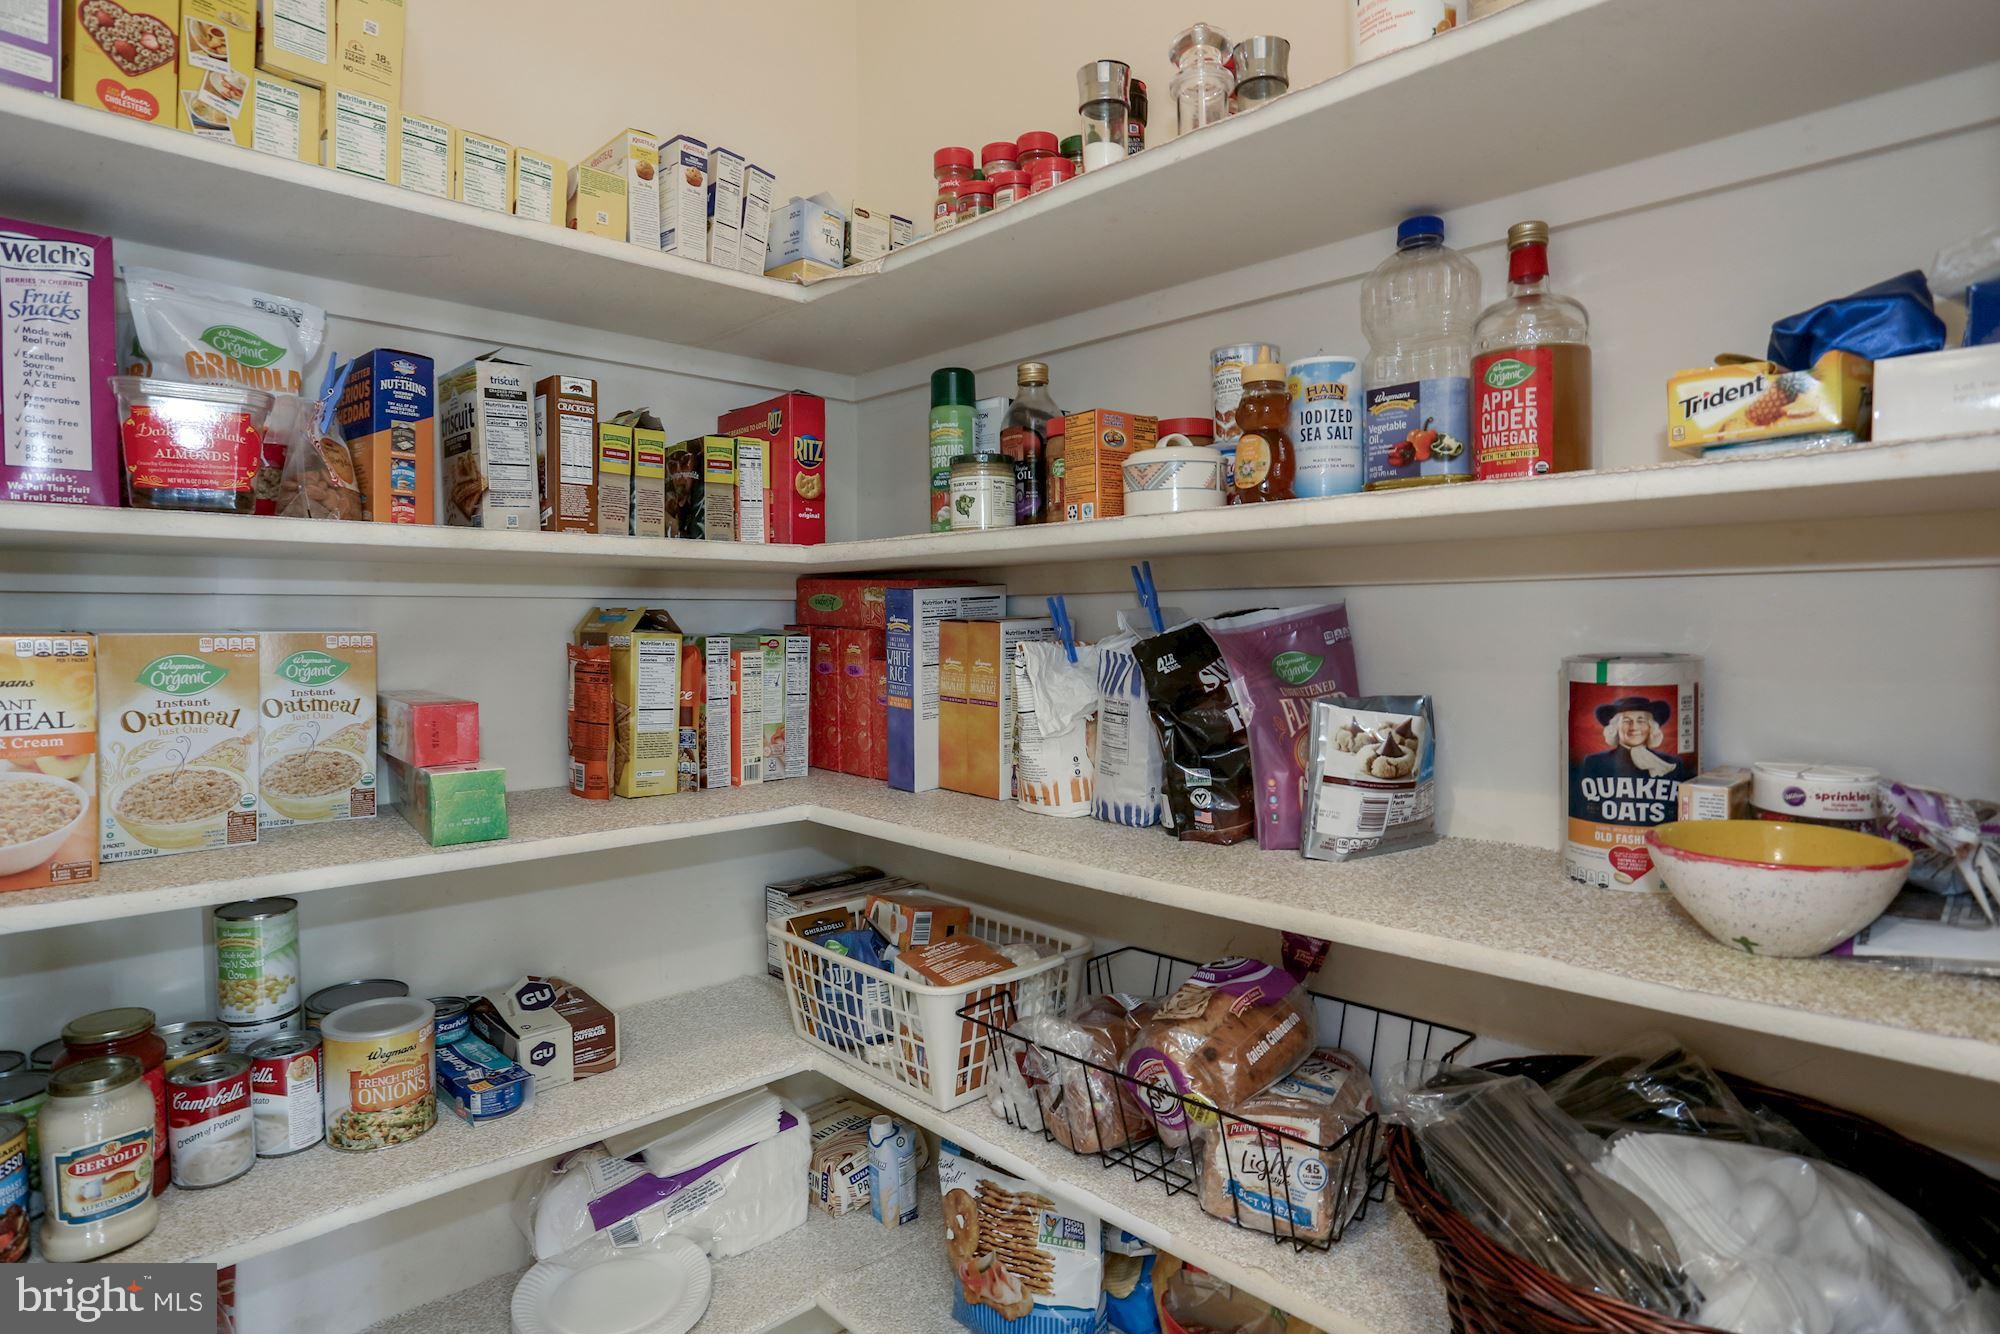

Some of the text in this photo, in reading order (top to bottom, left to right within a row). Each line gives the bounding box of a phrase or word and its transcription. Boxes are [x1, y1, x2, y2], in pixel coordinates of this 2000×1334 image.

[105, 95, 153, 116] CHOLESTEROL
[373, 121, 387, 133] 230
[434, 144, 447, 155] 230
[824, 234, 841, 249] TEA
[1, 242, 92, 268] Welch's
[48, 280, 85, 289] CHERRIES
[23, 289, 73, 306] Fruit
[8, 301, 81, 321] Snacks
[23, 327, 73, 341] Made with
[23, 336, 66, 349] Real Fruit
[213, 337, 269, 362] Organic
[23, 351, 65, 364] Excellent
[23, 361, 56, 372] Source
[184, 351, 302, 393] GRANOLA
[23, 370, 77, 383] of Vitamins
[490, 375, 520, 387] triscuit
[1489, 368, 1524, 386] Organic
[380, 379, 427, 398] NUT-THINS
[1307, 384, 1345, 397] HAIN
[24, 393, 81, 407] Preservative
[1375, 391, 1411, 404] Wegmans
[1482, 387, 1537, 412] APPLE
[1679, 374, 1766, 419] Trident
[24, 402, 46, 411] Free
[558, 402, 595, 415] CRACKERS
[25, 415, 80, 428] Gluten Free
[442, 402, 475, 438] triscuit
[515, 420, 528, 428] 120
[767, 410, 783, 432] RITZ
[1301, 408, 1353, 426] IODIZED
[1481, 407, 1538, 434] CIDER
[136, 424, 178, 437] Dark
[1301, 426, 1353, 442] SEA SALT
[1368, 421, 1407, 435] Vegetable
[25, 430, 64, 441] Fat Free
[1369, 435, 1379, 445] Oil
[1481, 429, 1539, 449] VINEGAR
[41, 446, 75, 457] Calorie
[154, 449, 231, 462] ALMONDS
[794, 436, 824, 462] RITZ
[1497, 451, 1508, 459] THE
[1510, 449, 1537, 458] MOTHER
[26, 455, 64, 466] Pouches
[1017, 470, 1034, 481] OIL
[47, 484, 65, 494] The
[67, 485, 91, 496] Fruit
[23, 492, 48, 503] Fruit
[798, 512, 821, 520] original
[159, 659, 205, 673] Wegmans
[293, 655, 331, 667] Wegmans
[887, 650, 911, 668] WHITE
[286, 664, 336, 682] Organic
[889, 668, 907, 683] RICE
[151, 671, 211, 691] Organic
[157, 698, 211, 708] Instant
[262, 698, 361, 719] Oatmeal
[121, 708, 241, 734] Oatmeal
[313, 712, 334, 720] Oats
[183, 725, 209, 734] Oats
[11, 738, 65, 749] Cream
[1815, 791, 1871, 802] sprinkles
[1601, 800, 1665, 822] OATS
[1594, 831, 1612, 842] OLD
[804, 922, 845, 936] GHIRARDELLI
[520, 988, 551, 1005] GU
[573, 1030, 607, 1043] OUTRAGE
[574, 1025, 605, 1037] CHOCOLATE
[1246, 1012, 1300, 1066] Raisin Cinnamon
[367, 1043, 417, 1063] Wegmans
[532, 1046, 554, 1061] GU
[358, 1063, 425, 1089] FRENCH FRIED
[173, 1082, 247, 1114] Campbell's
[358, 1076, 426, 1106] ONIONS
[204, 1130, 212, 1138] of
[213, 1114, 242, 1133] Potato
[812, 1115, 863, 1140] PROTEIN
[74, 1144, 145, 1175] BERTOLLI
[1242, 1150, 1293, 1181] Light
[851, 1167, 869, 1184] LUNA
[1305, 1164, 1320, 1174] 45
[80, 1197, 117, 1213] ALFREDO
[1239, 1191, 1297, 1221] SOFT WHEAT
[1065, 1218, 1084, 1228] NON
[1065, 1226, 1084, 1234] GMO
[1041, 1236, 1084, 1249] VERIFIED
